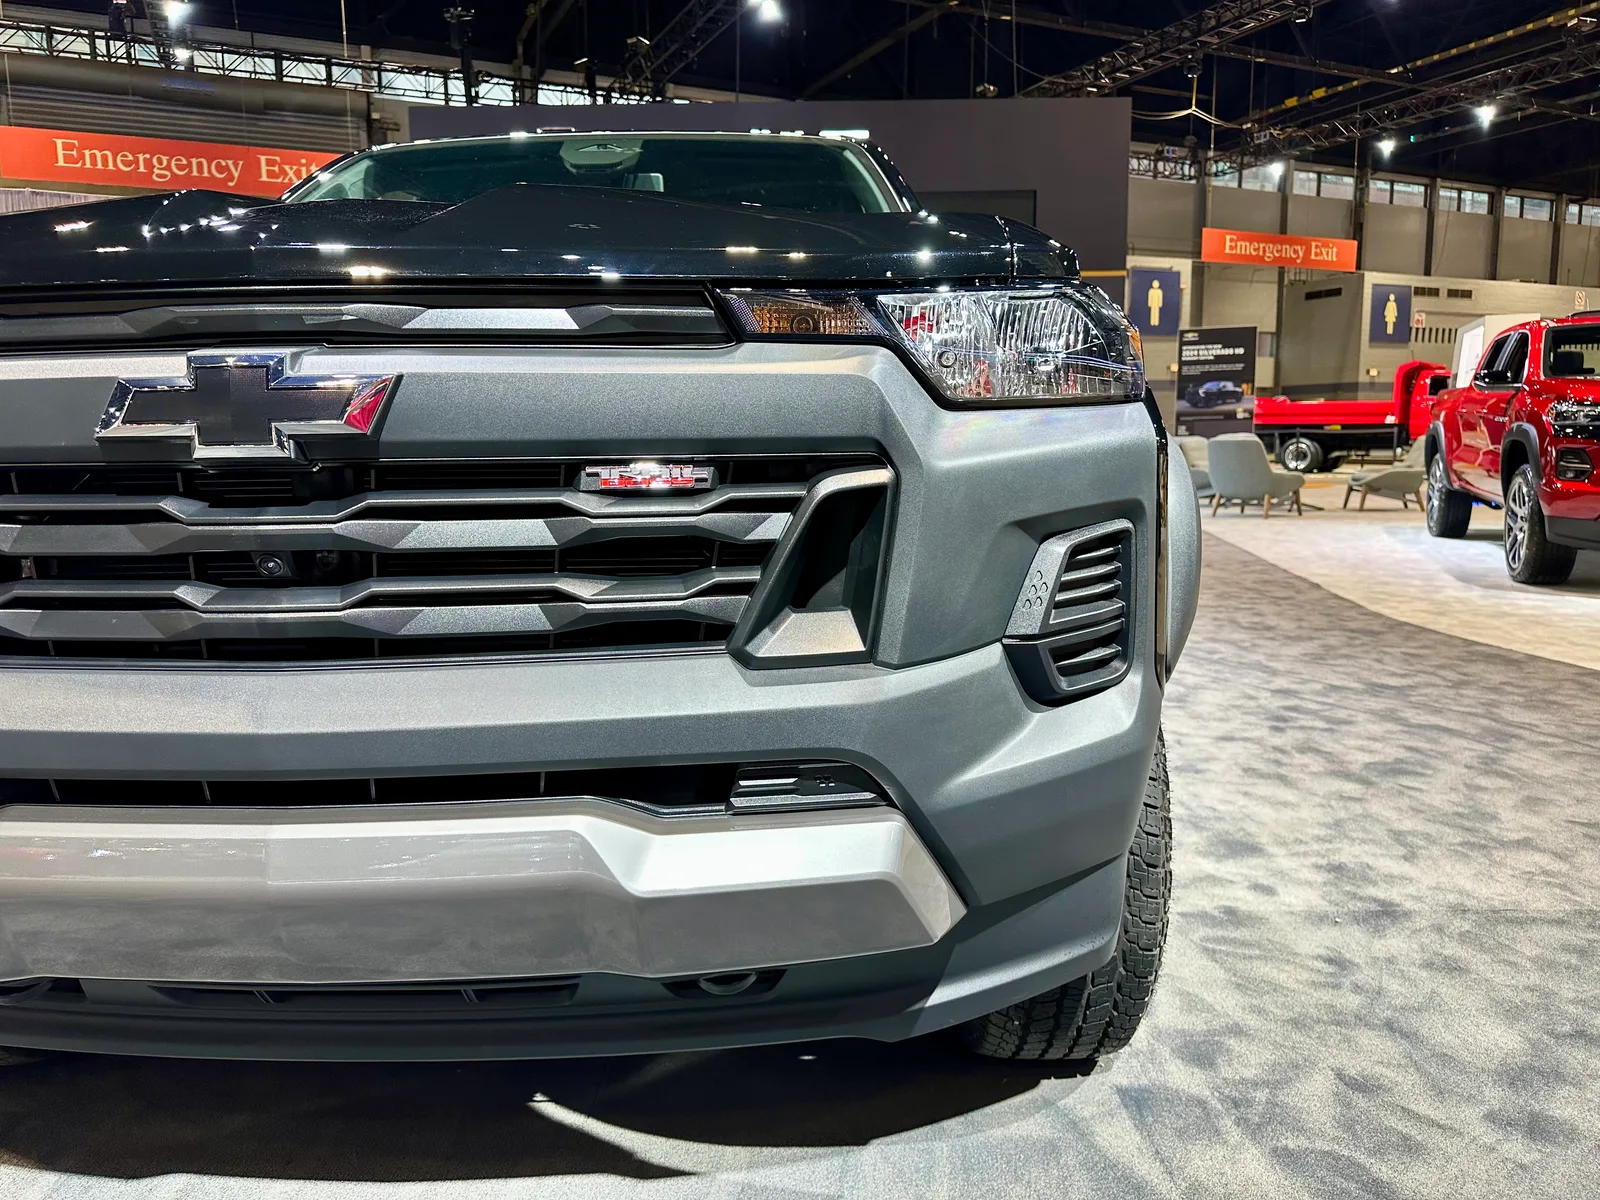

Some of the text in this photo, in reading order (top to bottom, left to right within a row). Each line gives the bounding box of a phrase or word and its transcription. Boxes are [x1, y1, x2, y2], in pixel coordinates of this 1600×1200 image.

[52, 138, 244, 186] Emergency
[1224, 234, 1337, 263] Emergency Exit
